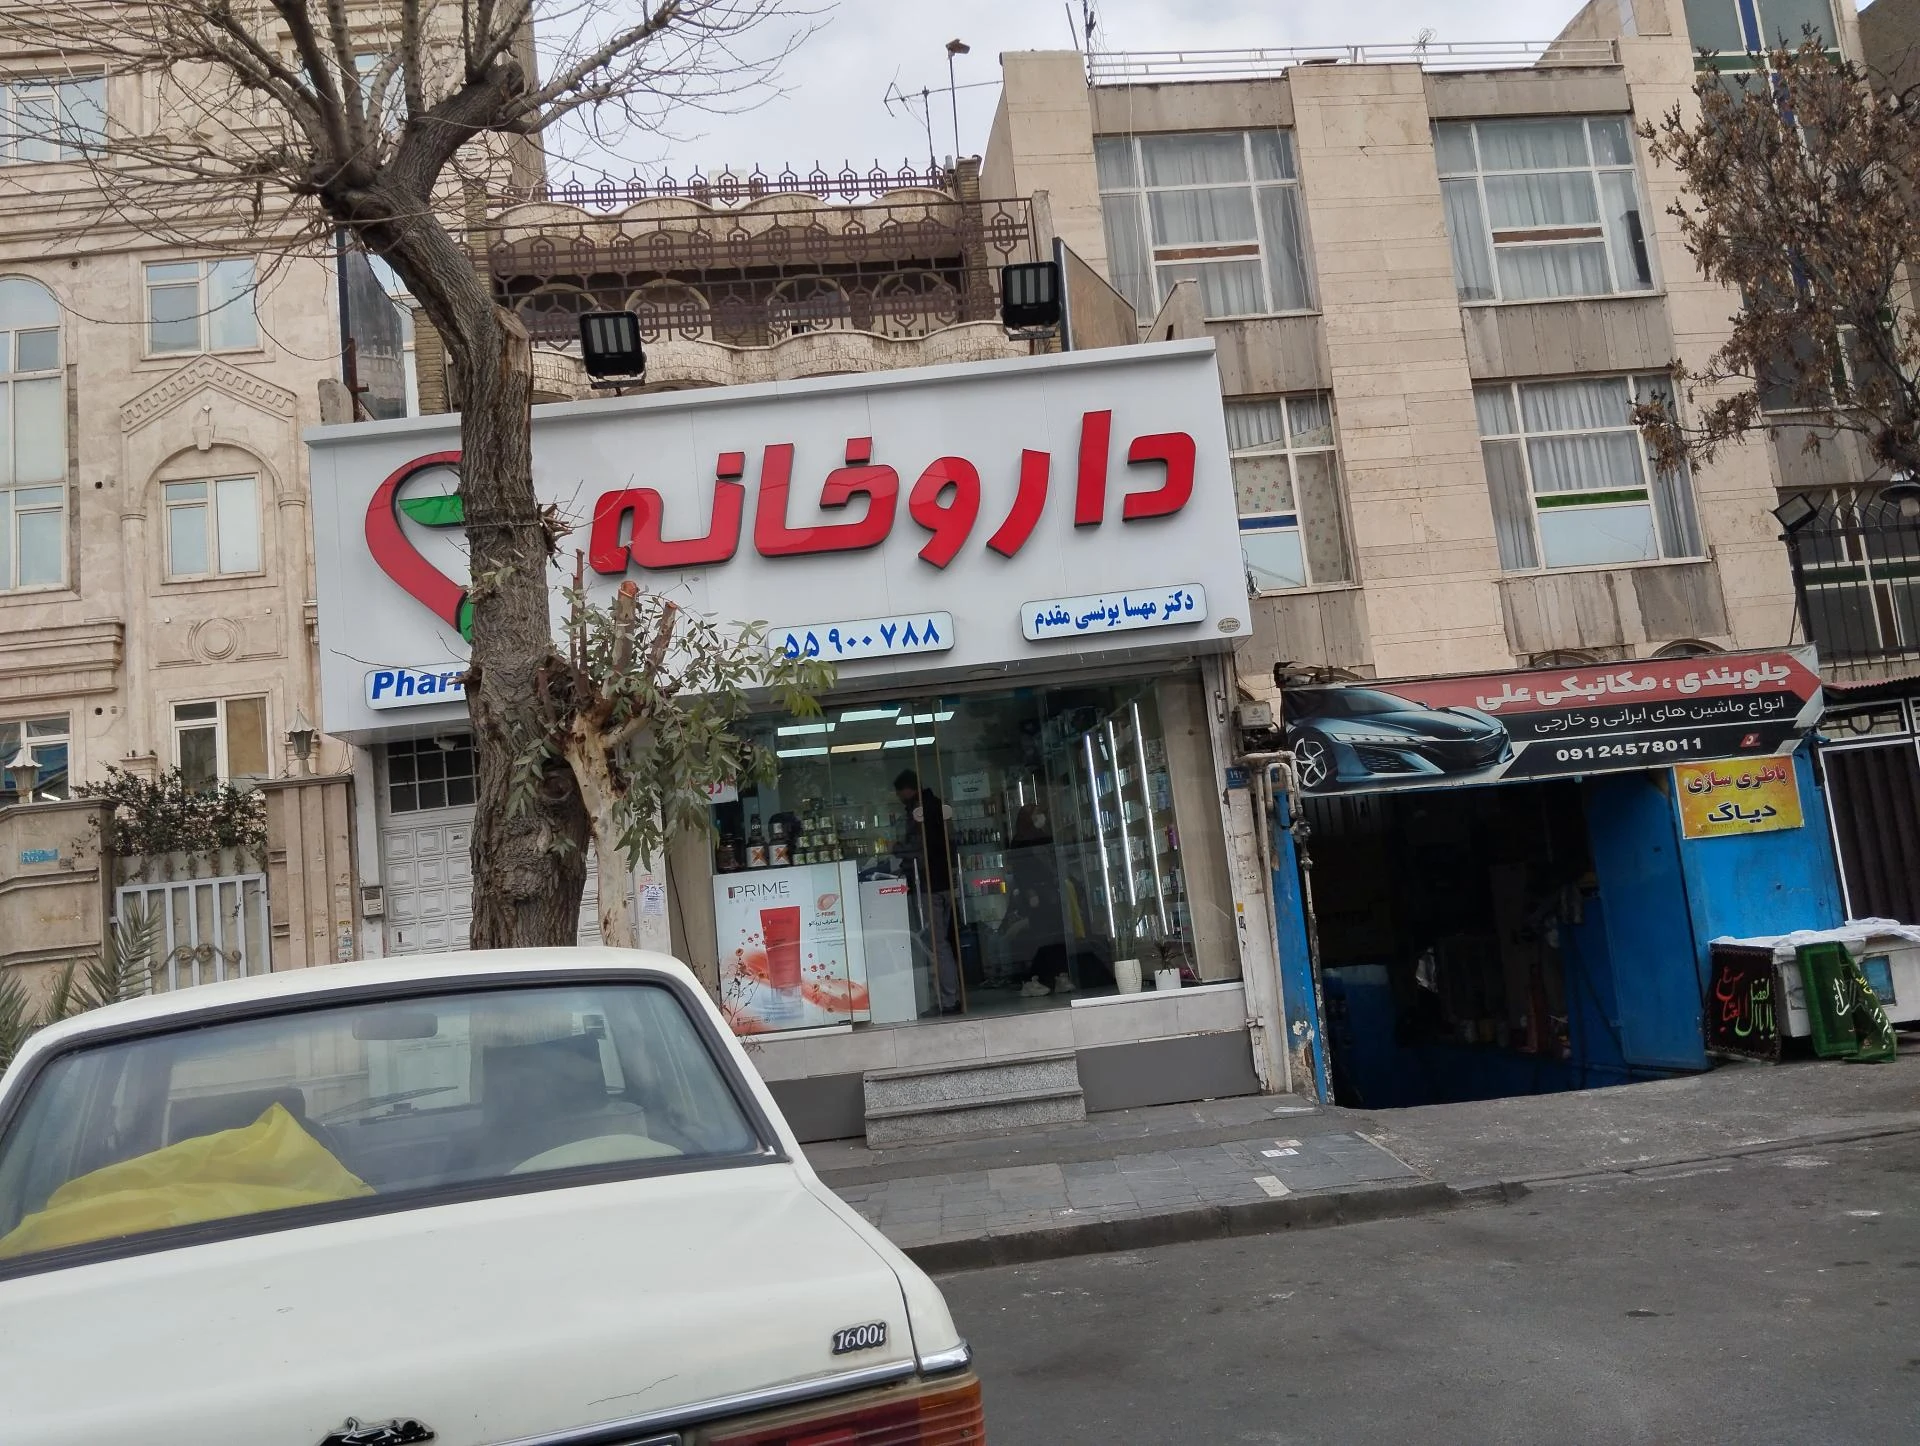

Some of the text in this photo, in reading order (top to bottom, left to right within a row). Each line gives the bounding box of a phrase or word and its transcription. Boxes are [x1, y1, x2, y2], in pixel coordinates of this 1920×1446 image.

[589, 409, 1197, 576] داروخانه
[1034, 590, 1194, 634] دکتر مهسا یونسی مقدم
[783, 619, 940, 660] ۵۵۹۰۰۷۸۸
[1475, 683, 1532, 711] علی
[1535, 671, 1657, 706] مکانیکی
[1534, 696, 1785, 733] انواع ماشین های ایرانی و خارجی
[1556, 737, 1702, 761] 09124578011
[1687, 764, 1787, 794] باطری سازی
[1707, 802, 1777, 823] دیاگ
[730, 880, 790, 899] PRIME
[835, 1323, 887, 1351] 1600i
